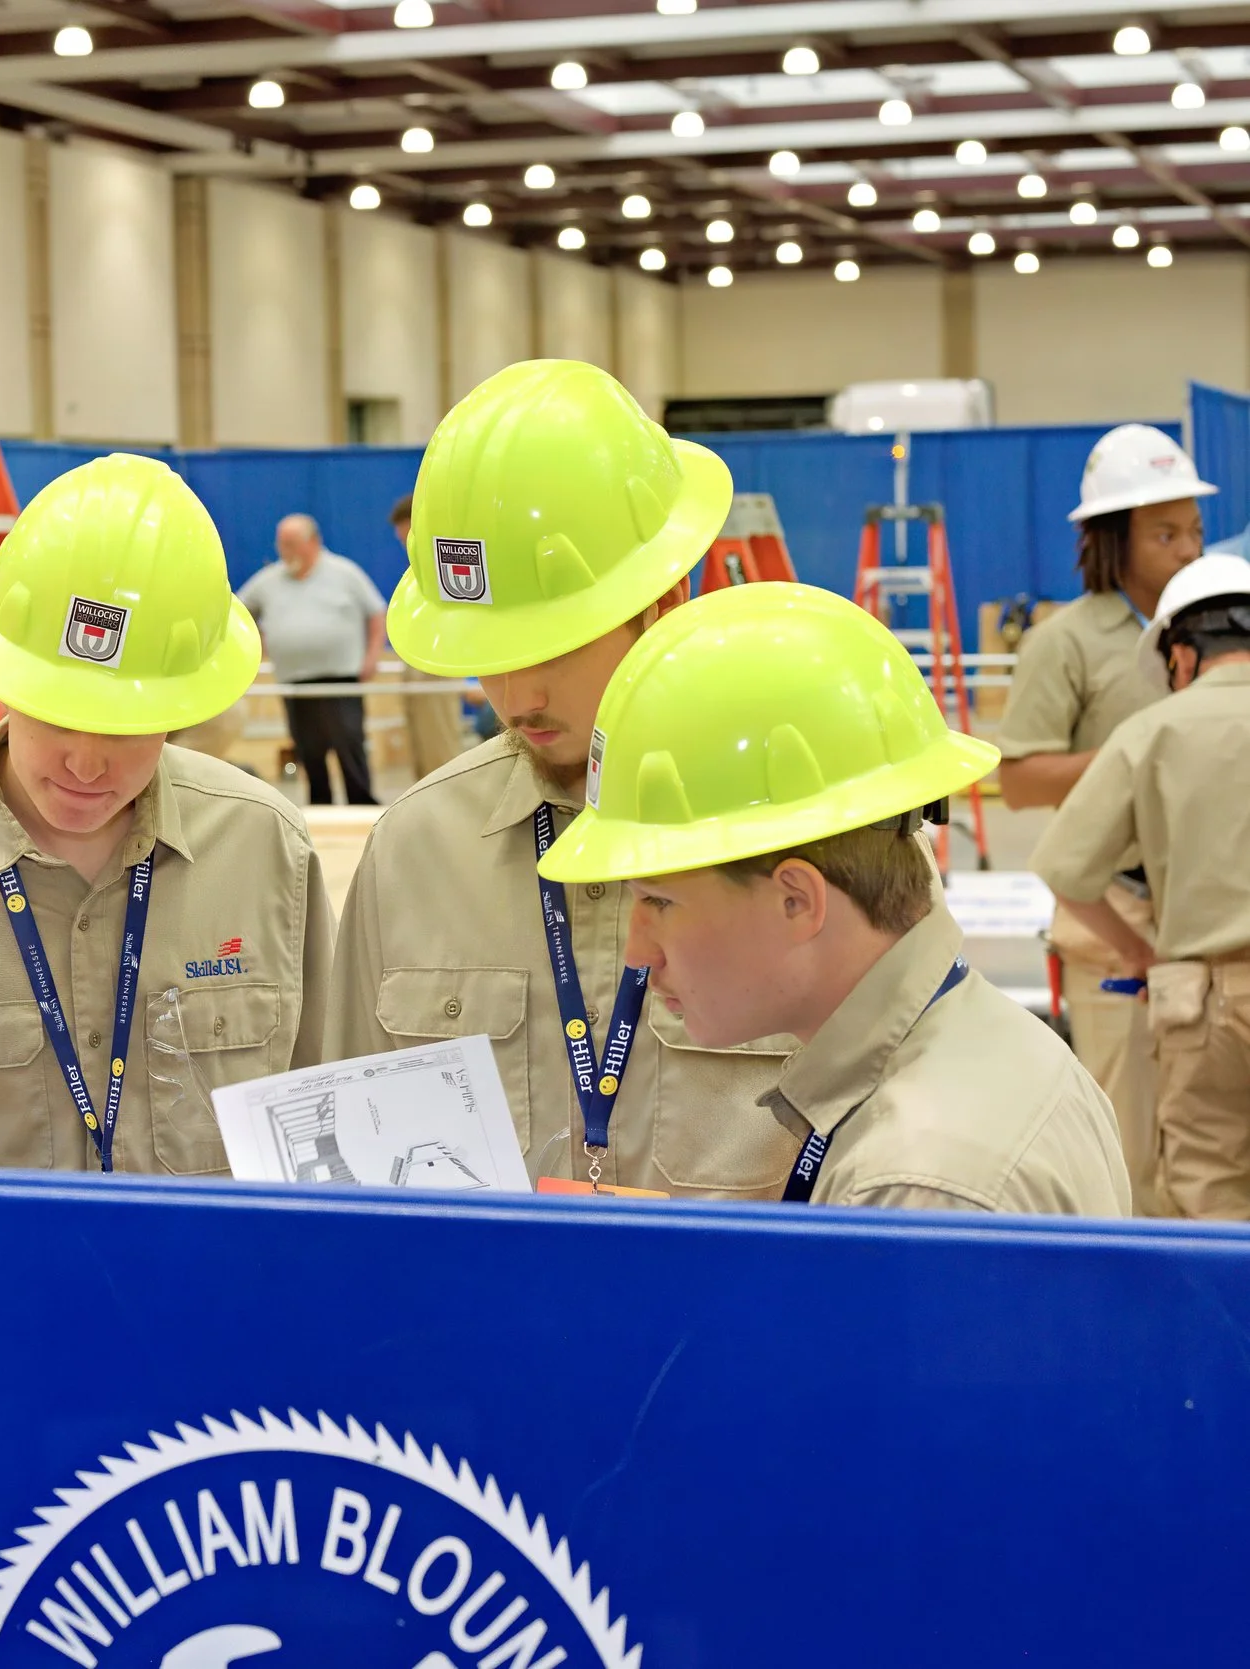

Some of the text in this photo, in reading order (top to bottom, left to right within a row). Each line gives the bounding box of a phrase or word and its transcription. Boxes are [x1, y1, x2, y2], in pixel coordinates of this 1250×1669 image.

[440, 545, 478, 556] WILLOCKS
[441, 554, 479, 564] BROTHERS
[76, 612, 118, 630] BROTHERS
[77, 603, 121, 622] WILLOCKS
[29, 944, 51, 1000] TENNESSEE
[185, 957, 243, 979] SkillsUSA
[553, 925, 570, 984] TENNESSEE
[119, 967, 132, 1025] TENNESSEE
[571, 1038, 593, 1094] Hiller
[604, 1020, 632, 1077] Hiller
[66, 1064, 91, 1115] Hiller
[105, 1076, 122, 1128] Hiller
[25, 1479, 300, 1669] WILLIAM
